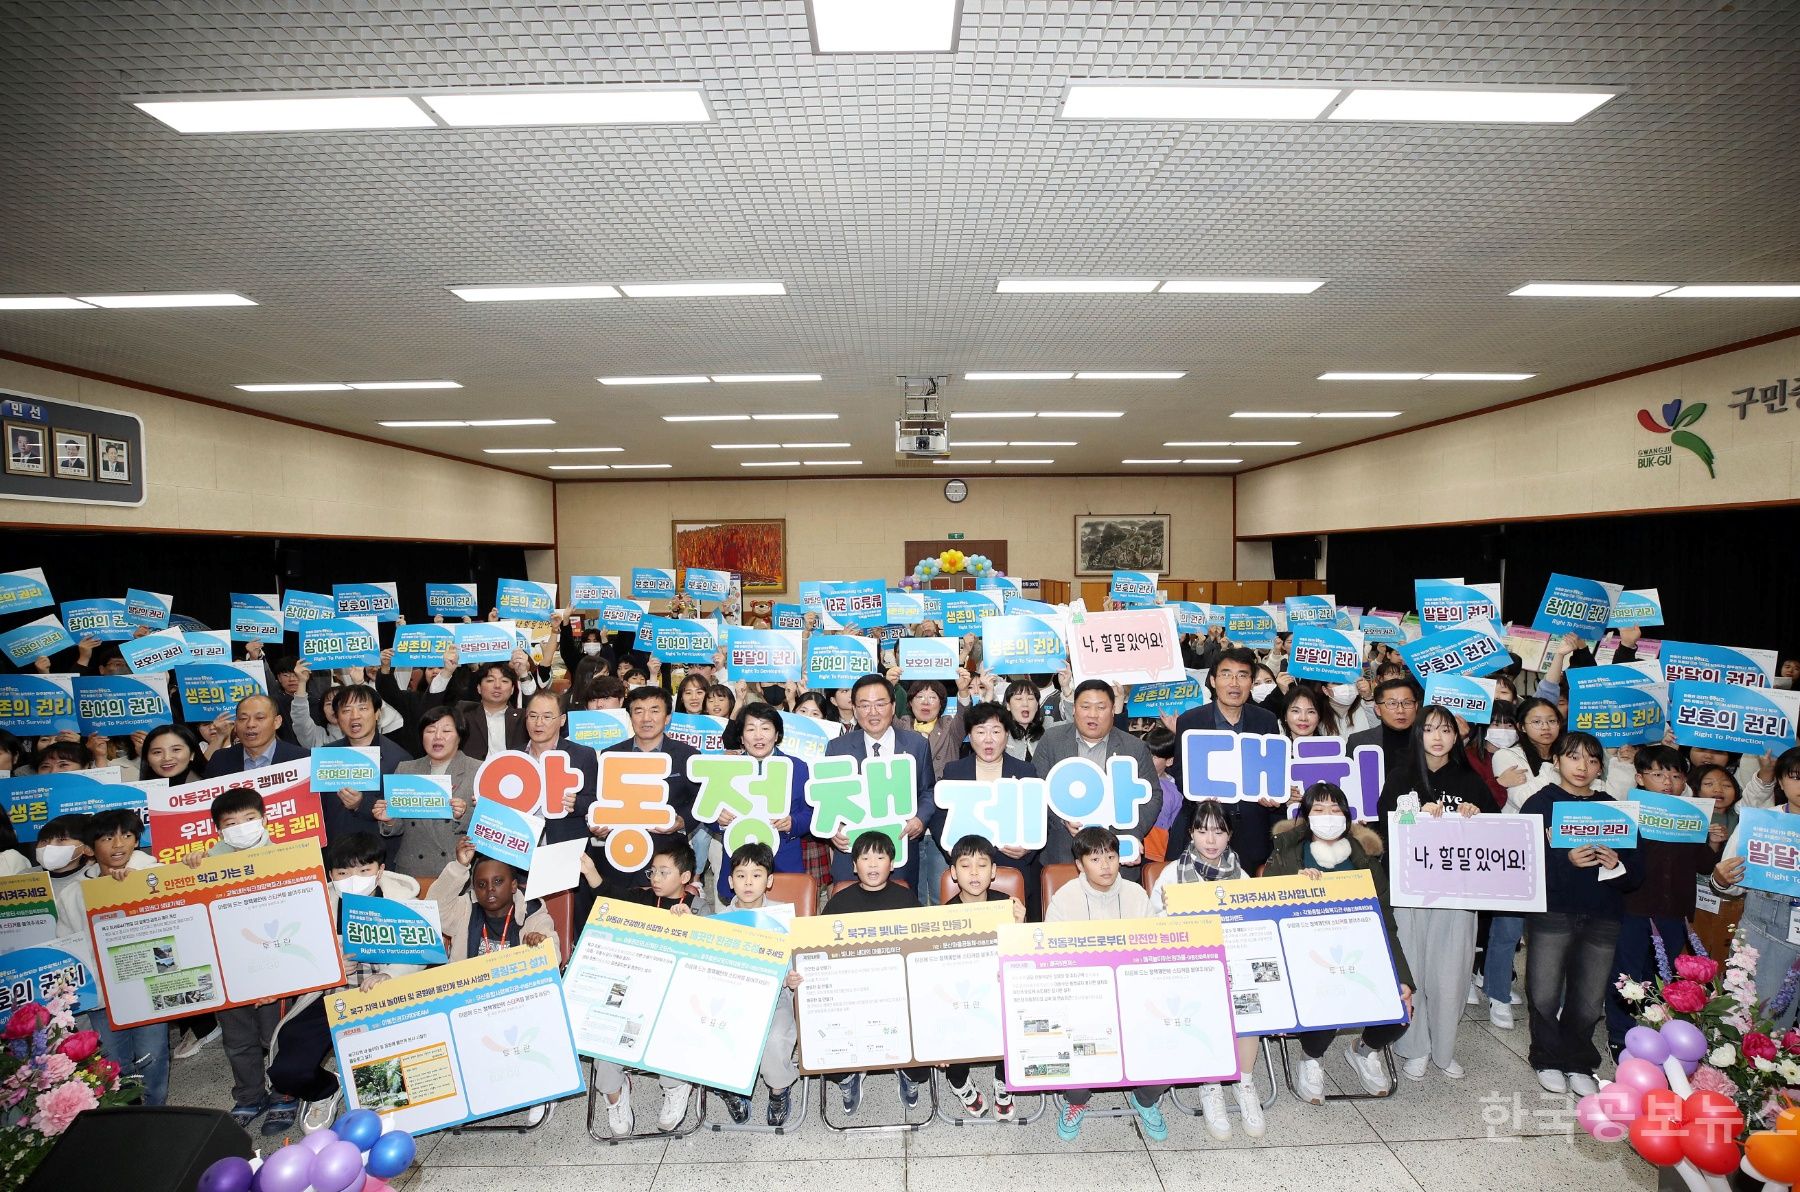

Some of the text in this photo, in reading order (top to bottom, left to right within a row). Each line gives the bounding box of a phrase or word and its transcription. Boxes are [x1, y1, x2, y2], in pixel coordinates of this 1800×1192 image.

[1638, 446, 1672, 456] GWANGJU
[1638, 454, 1672, 468] BUK-GU
[658, 580, 674, 591] 권리
[1138, 583, 1154, 595] 권리
[18, 588, 44, 603] 권리
[457, 596, 474, 607] 권리
[500, 595, 551, 610] 생존의 권리
[338, 597, 395, 612] 보호의 권리
[1545, 596, 1611, 624] 참여의 권리
[1635, 606, 1656, 618] 권리
[149, 609, 165, 619] 권리
[286, 605, 319, 620] 참여의
[947, 609, 977, 624] 생존의
[1318, 608, 1336, 620] 권리
[1423, 604, 1495, 622] 발달의 권리
[69, 614, 109, 631] 참여의
[260, 625, 279, 635] 권리
[1229, 619, 1274, 631] 생존의 권리
[1552, 618, 1566, 627] Right
[42, 632, 64, 648] 권리
[303, 636, 375, 656] 참여의 권리
[396, 639, 432, 654] 생존의
[459, 640, 511, 654] 발달의 권리
[657, 635, 715, 650] 참여의 권리
[1032, 637, 1061, 656] 권리
[163, 646, 183, 659] 권리
[206, 646, 226, 656] 권리
[732, 649, 797, 666] 발달의 권리
[1295, 646, 1359, 669] 발달의 권리
[1416, 636, 1498, 677] 보호의 권리
[811, 655, 874, 672] 참여의 권리
[905, 657, 953, 668] 보호의 권리
[1665, 664, 1721, 683] 발달의
[184, 687, 226, 705] 생존의
[1133, 683, 1200, 704] 생존의 권리
[36, 697, 74, 717] 권리
[80, 697, 163, 719] 참여의 권리
[1431, 694, 1487, 712] 보호의 권리
[1576, 706, 1661, 730] 생존의 권리
[1677, 704, 1789, 739] 보호의 권리
[603, 729, 622, 740] 권리
[1694, 731, 1765, 746] Right To Protection
[317, 768, 375, 780] 참여의 권리
[168, 785, 225, 809] 아동권리
[257, 768, 299, 790] 캠페인
[391, 796, 446, 808] 참여의 권리
[180, 798, 297, 840] 우리 권리
[289, 812, 320, 835] 권리
[1676, 817, 1703, 832] 권리
[1560, 824, 1629, 836] 발달의 권리
[474, 823, 530, 854] 발달의 권리
[1747, 838, 1800, 872] 발달
[164, 863, 255, 891] 안전한 학교 가는 길
[1765, 871, 1790, 882] Right
[1277, 886, 1327, 902] 감사합니다!
[348, 921, 436, 946] 참여의 권리
[847, 925, 878, 940] 북구를
[942, 917, 973, 932] 만들기
[1047, 934, 1127, 950] 전동킥보드로부터
[360, 947, 377, 955] Right
[386, 947, 425, 956] Participation
